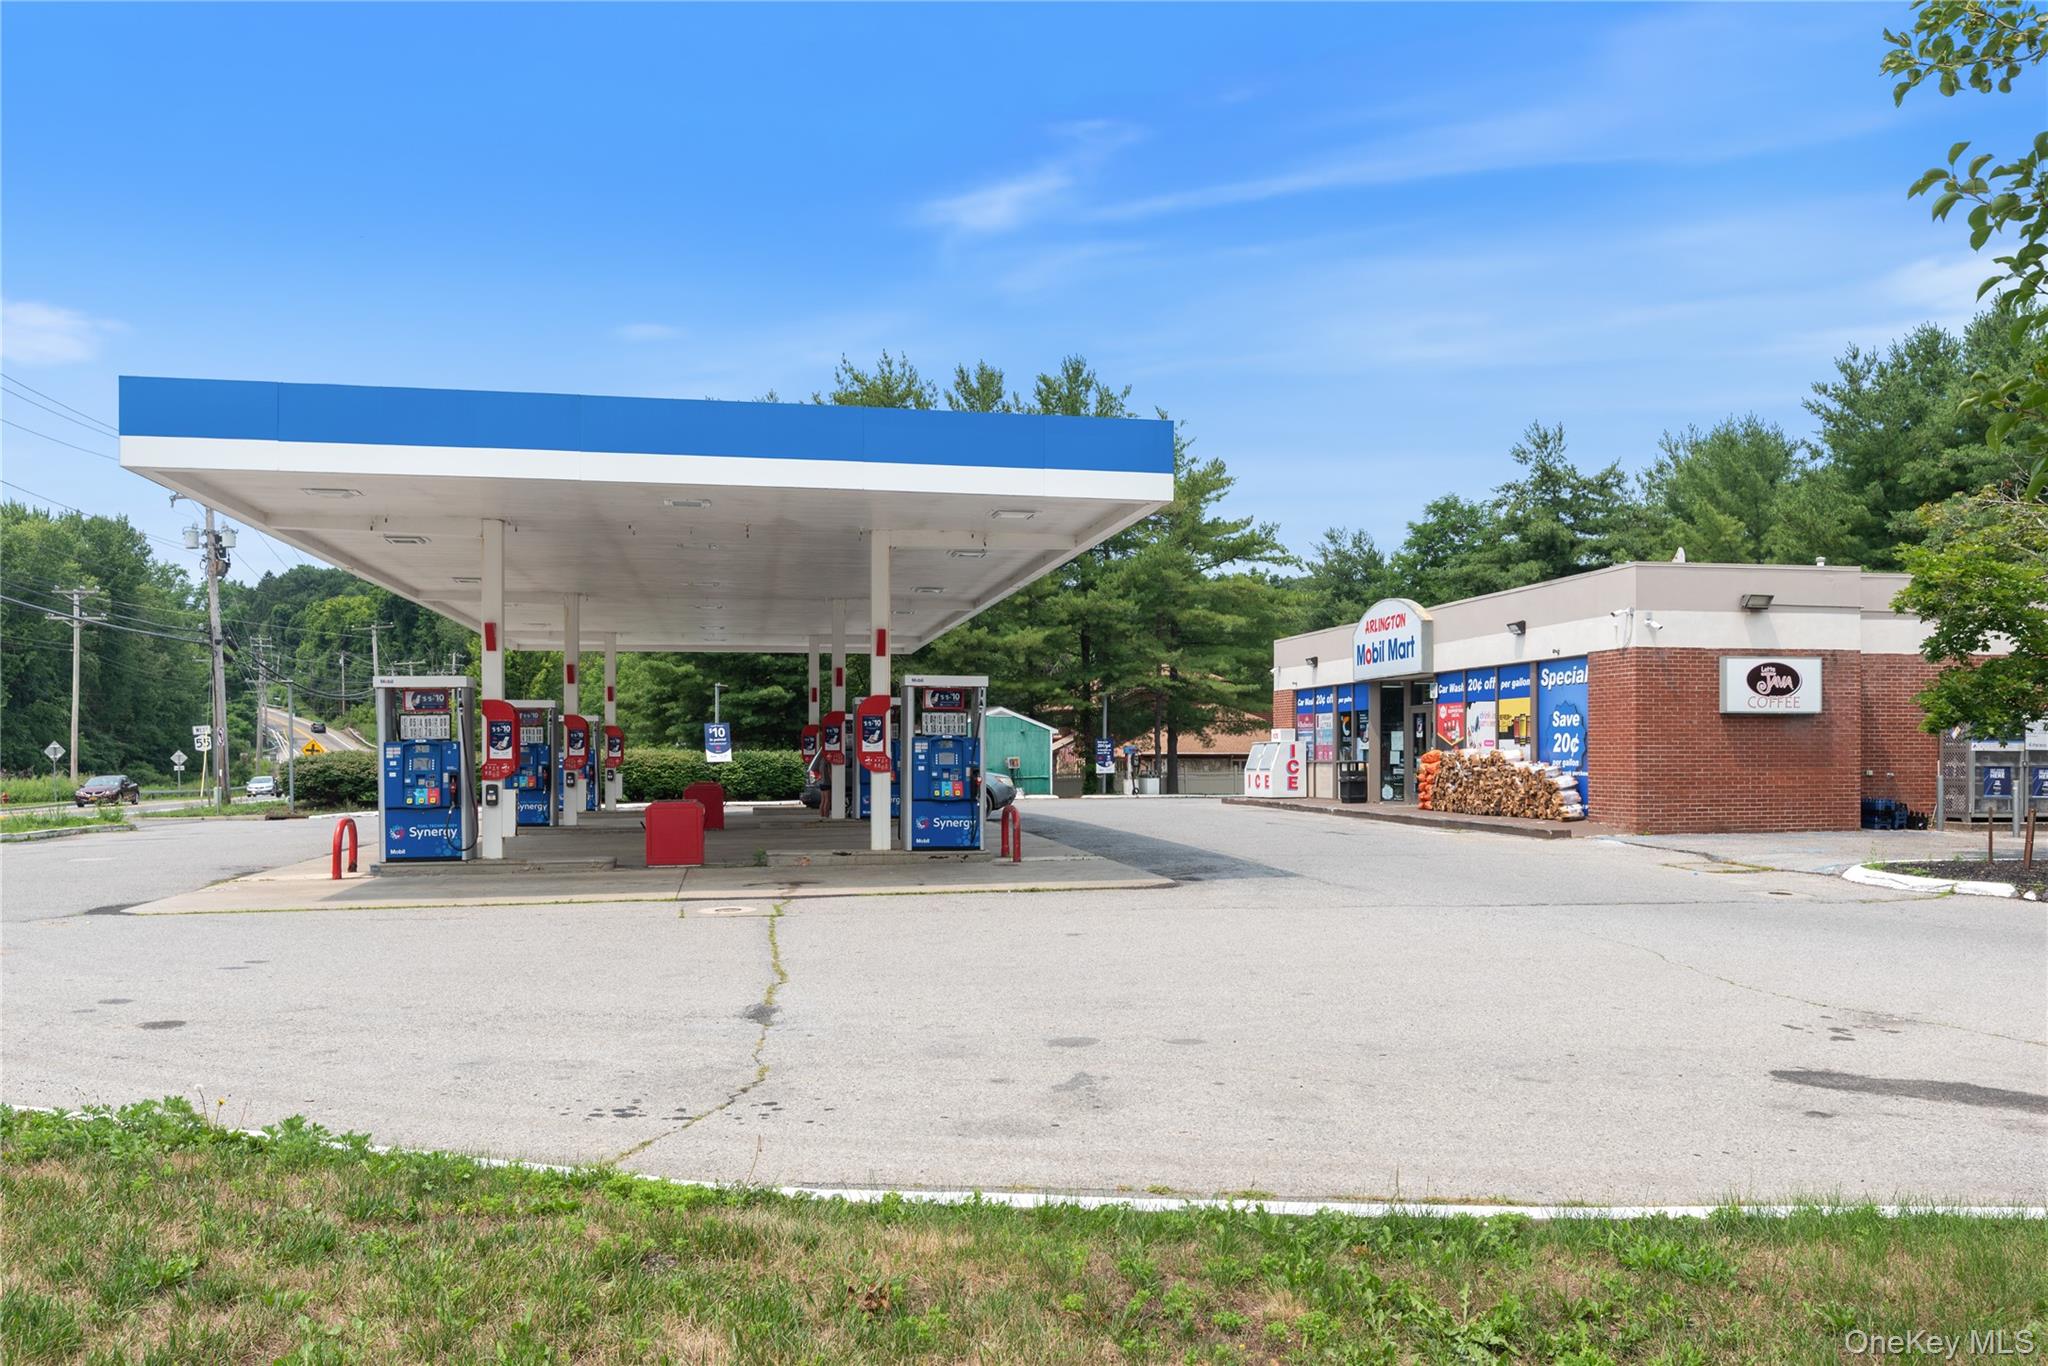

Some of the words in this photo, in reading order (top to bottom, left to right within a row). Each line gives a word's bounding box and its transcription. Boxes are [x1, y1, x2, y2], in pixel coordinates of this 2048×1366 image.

[1365, 613, 1406, 634] ARLINGTON
[1357, 640, 1385, 666] Mobil
[1388, 635, 1415, 661] Mart
[1540, 664, 1588, 690] Special
[1439, 685, 1448, 694] Car
[1468, 678, 1482, 693] 20¢
[1501, 681, 1510, 690] per
[1747, 696, 1800, 709] COFFEE
[1552, 711, 1580, 727] Save
[1553, 733, 1580, 757] 20¢
[1287, 744, 1299, 790] ICE
[1562, 759, 1579, 767] gallon
[1248, 774, 1270, 788] ICE
[933, 817, 976, 830] Synergy
[409, 826, 457, 840] Synergy
